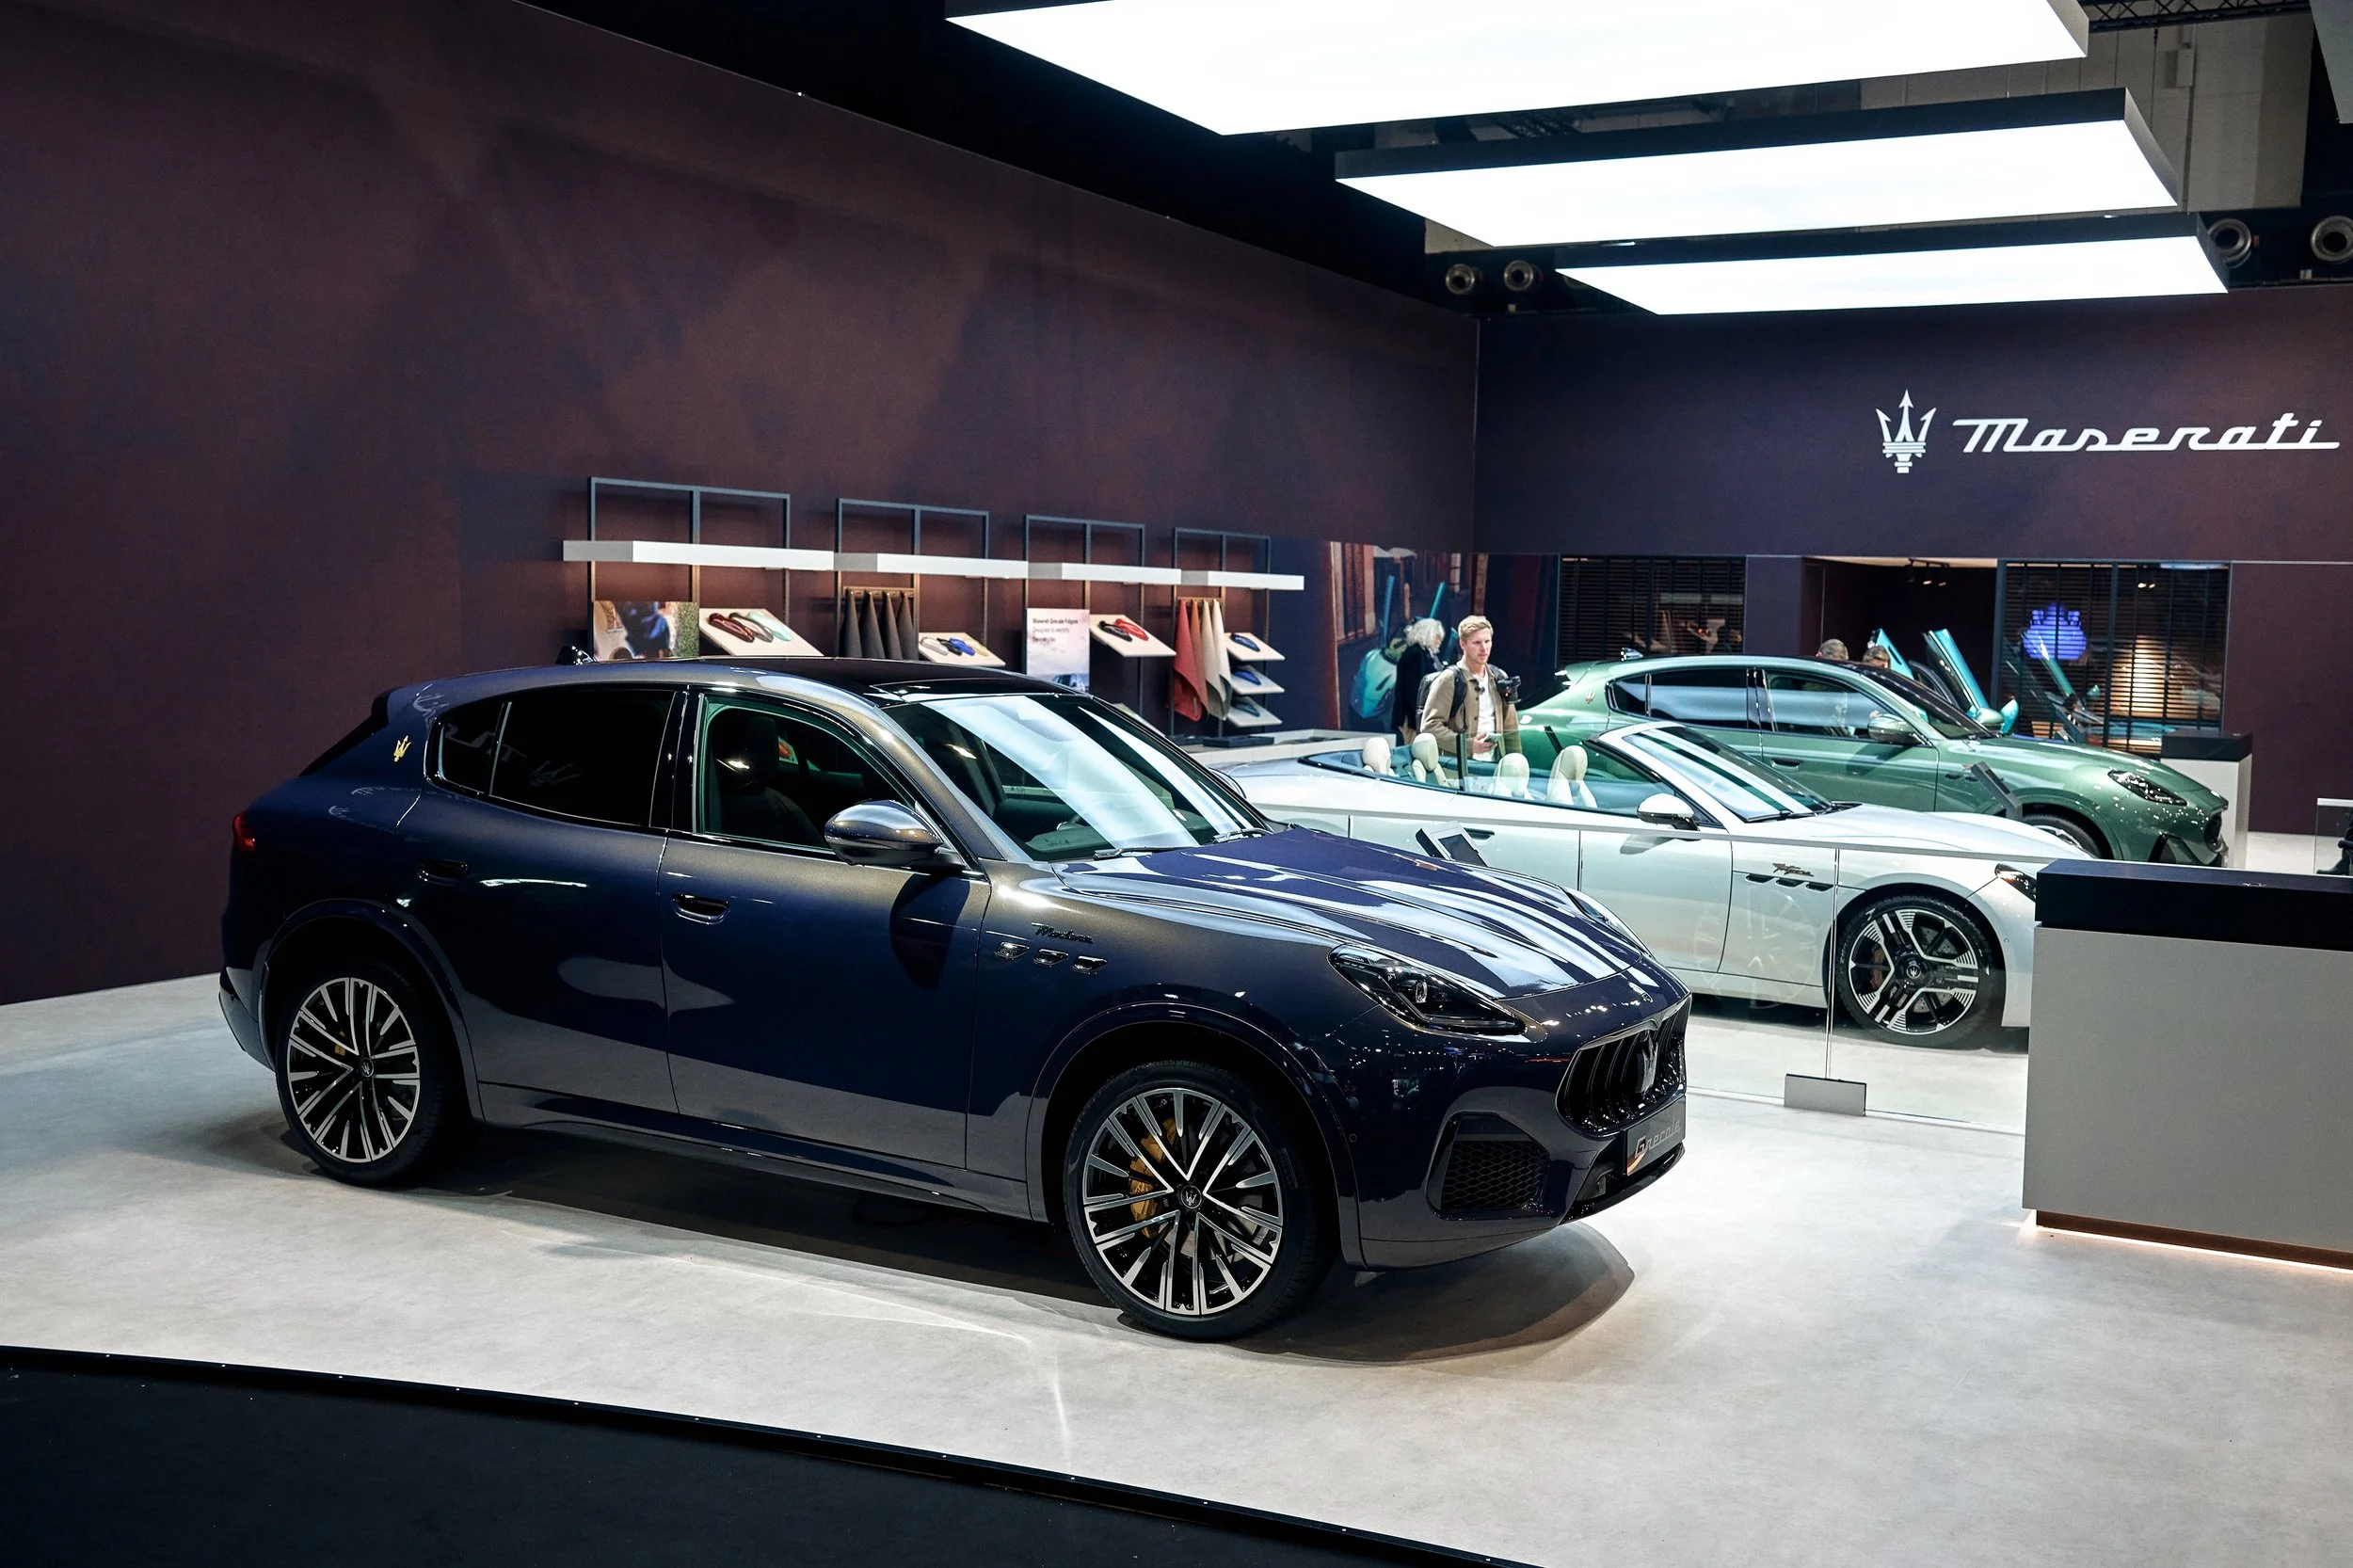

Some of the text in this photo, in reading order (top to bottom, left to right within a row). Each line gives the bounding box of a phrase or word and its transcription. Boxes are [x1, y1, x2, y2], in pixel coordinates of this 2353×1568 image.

[1952, 412, 2341, 453] Maserati
[1031, 921, 1094, 943] Modena
[1634, 1116, 1682, 1159] Grecale
